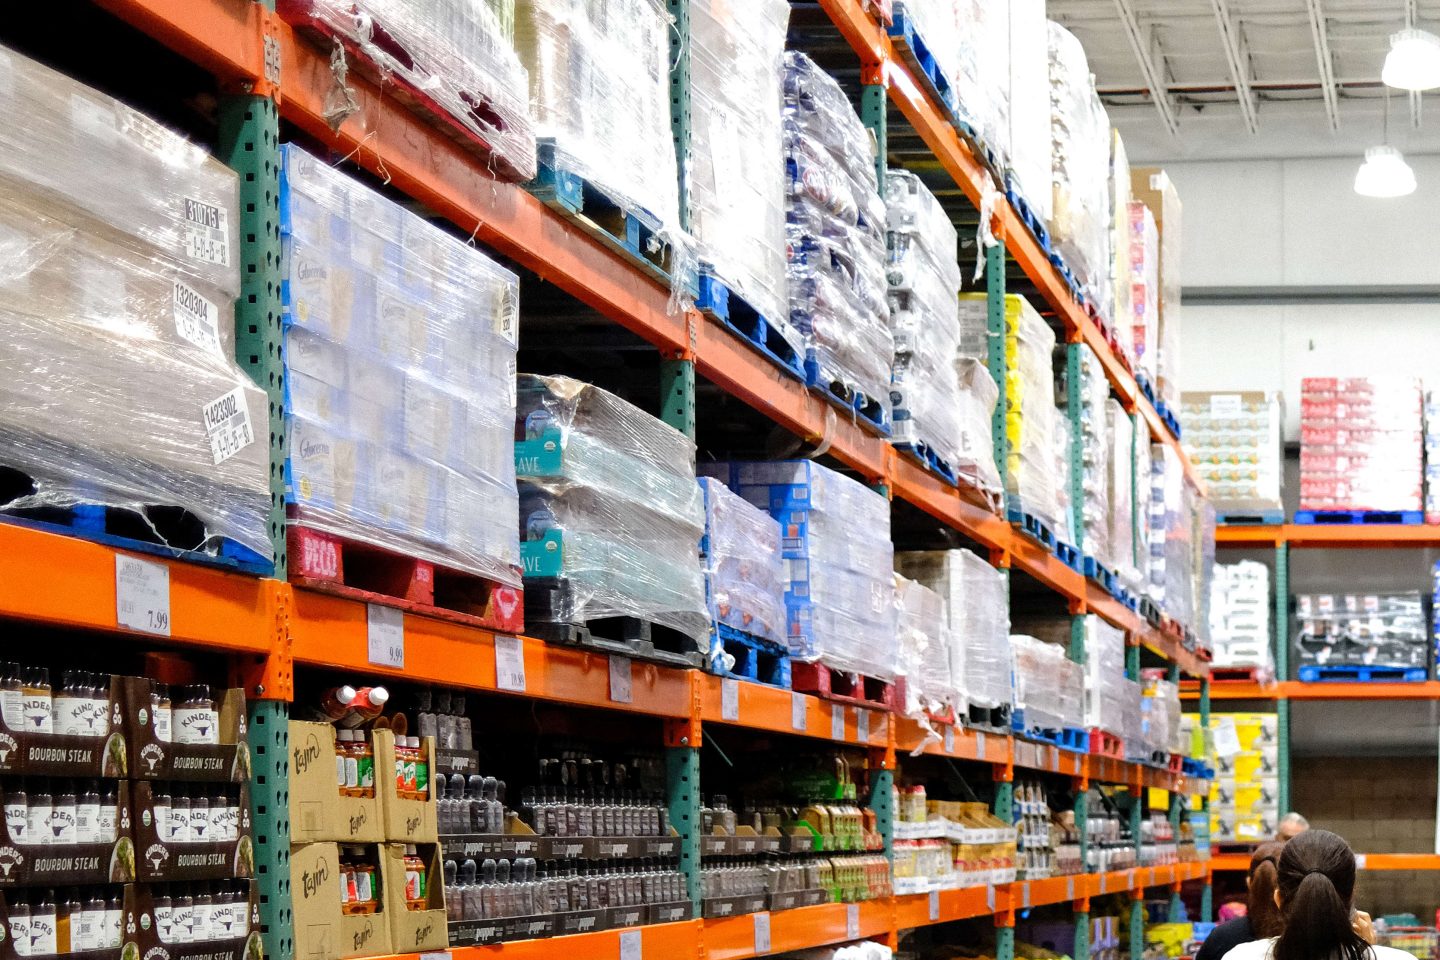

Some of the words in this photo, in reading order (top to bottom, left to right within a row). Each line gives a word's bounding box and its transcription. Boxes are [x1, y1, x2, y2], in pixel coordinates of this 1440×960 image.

[188, 200, 217, 228] 310715
[175, 284, 208, 321] 1320304
[205, 394, 238, 428] 1423302
[147, 609, 168, 630] 7.99
[29, 747, 67, 762] BOURBON
[68, 749, 93, 763] STEAK
[173, 756, 203, 769] BOURBON
[203, 758, 224, 770] STEAK
[34, 858, 73, 873] BOURBON
[74, 856, 100, 871] STEAK
[177, 853, 208, 868] BOURBON
[207, 853, 227, 866] STEAK
